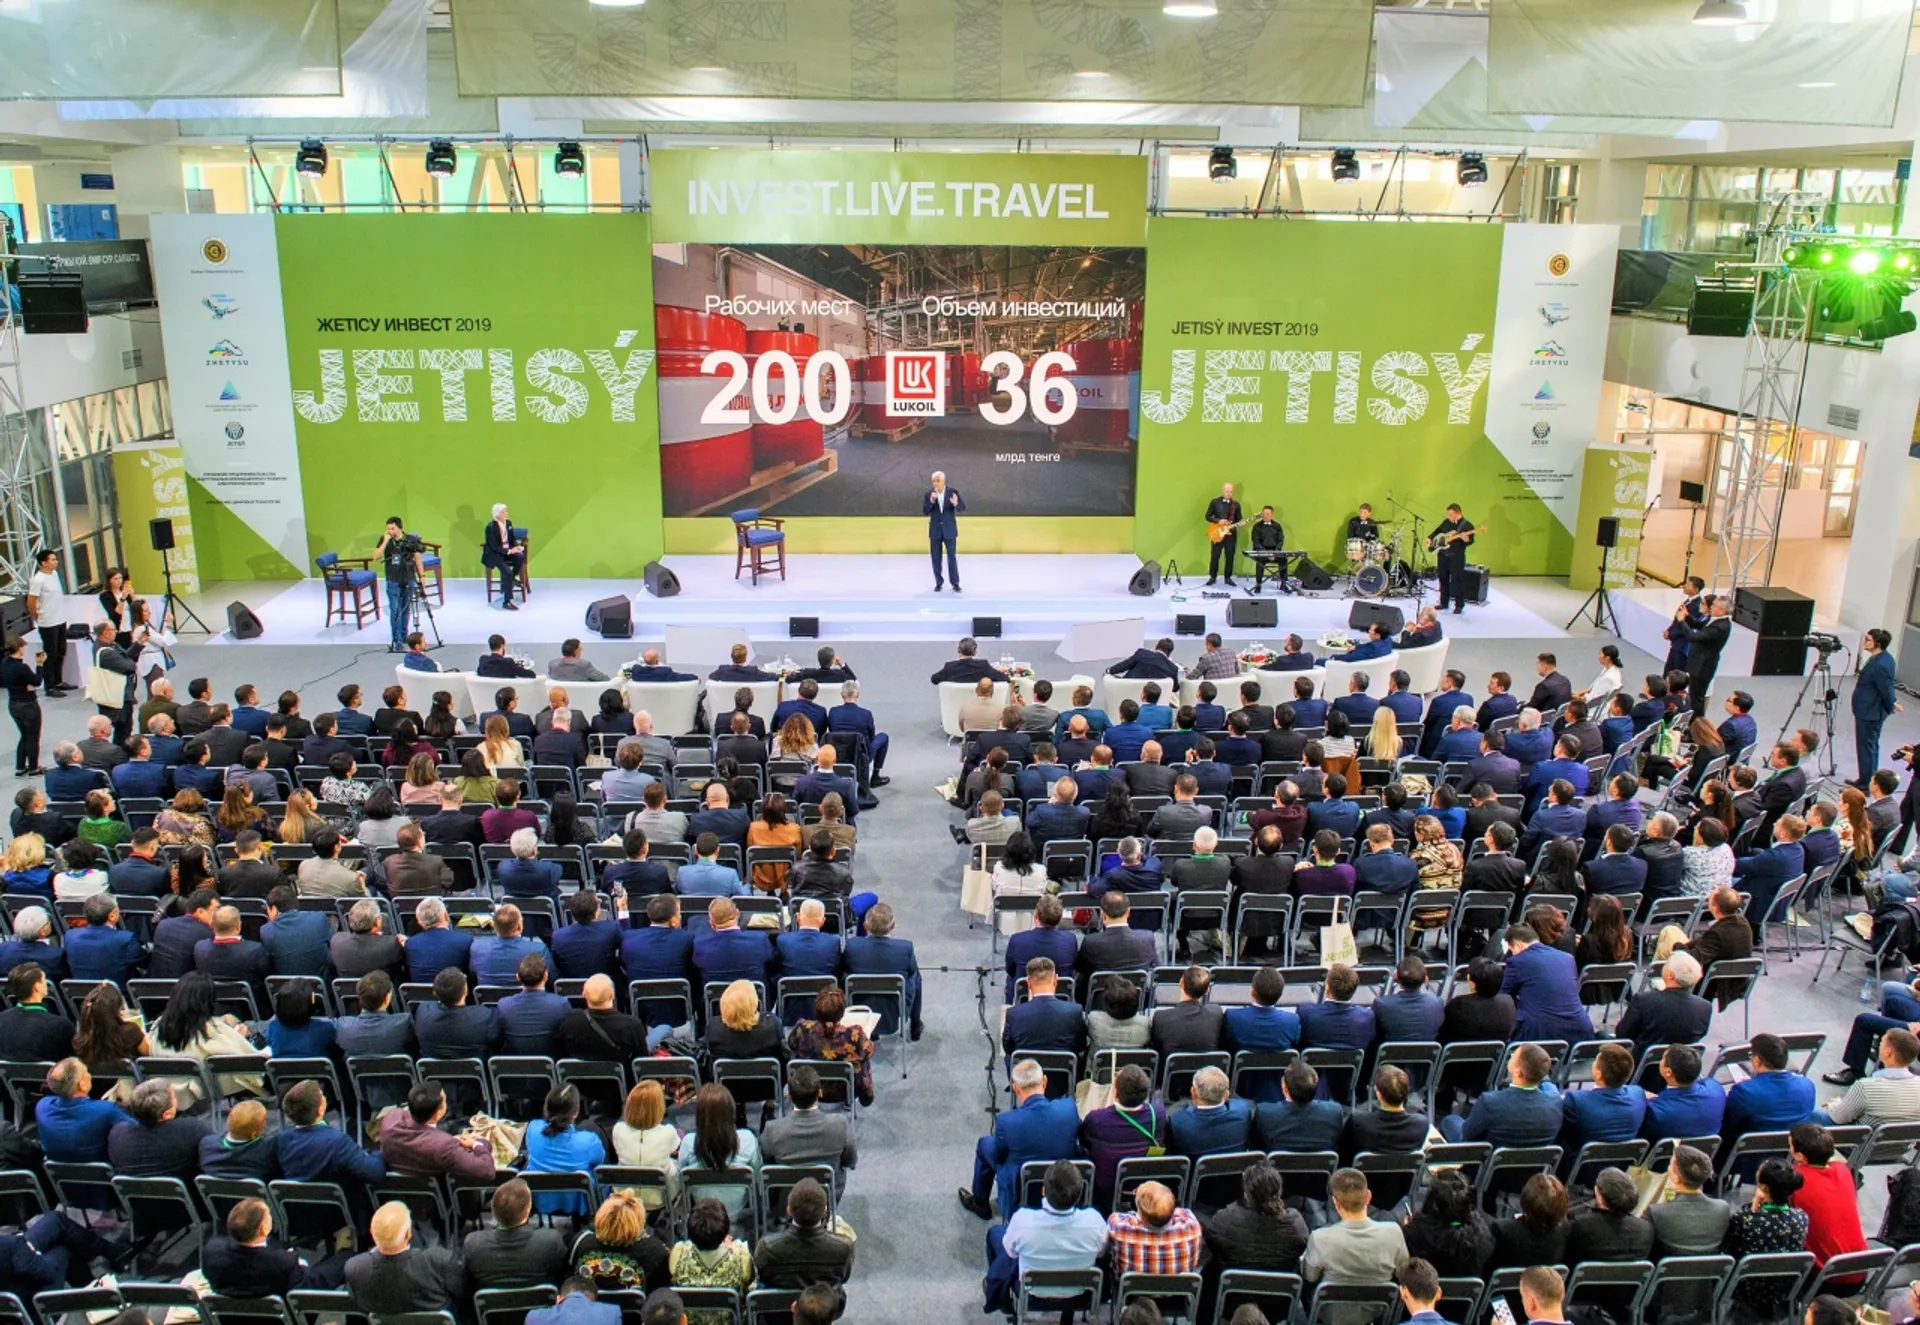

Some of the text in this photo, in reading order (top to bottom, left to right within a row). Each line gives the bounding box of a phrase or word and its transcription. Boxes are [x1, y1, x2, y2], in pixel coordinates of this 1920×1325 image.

[687, 180, 1110, 219] INVEST.LIVE.TRAVEL
[704, 295, 853, 317] Рабочих мест
[922, 296, 1126, 318] Объем инвестиций
[384, 317, 452, 332] ИНВЕСТ
[456, 317, 492, 332] 2019
[1227, 321, 1282, 336] INVEST
[1285, 322, 1319, 336] 2019
[700, 350, 852, 425] 200
[979, 350, 1078, 426] 36
[893, 401, 936, 412] LUKOIL
[995, 452, 1061, 465] млрд тенге
